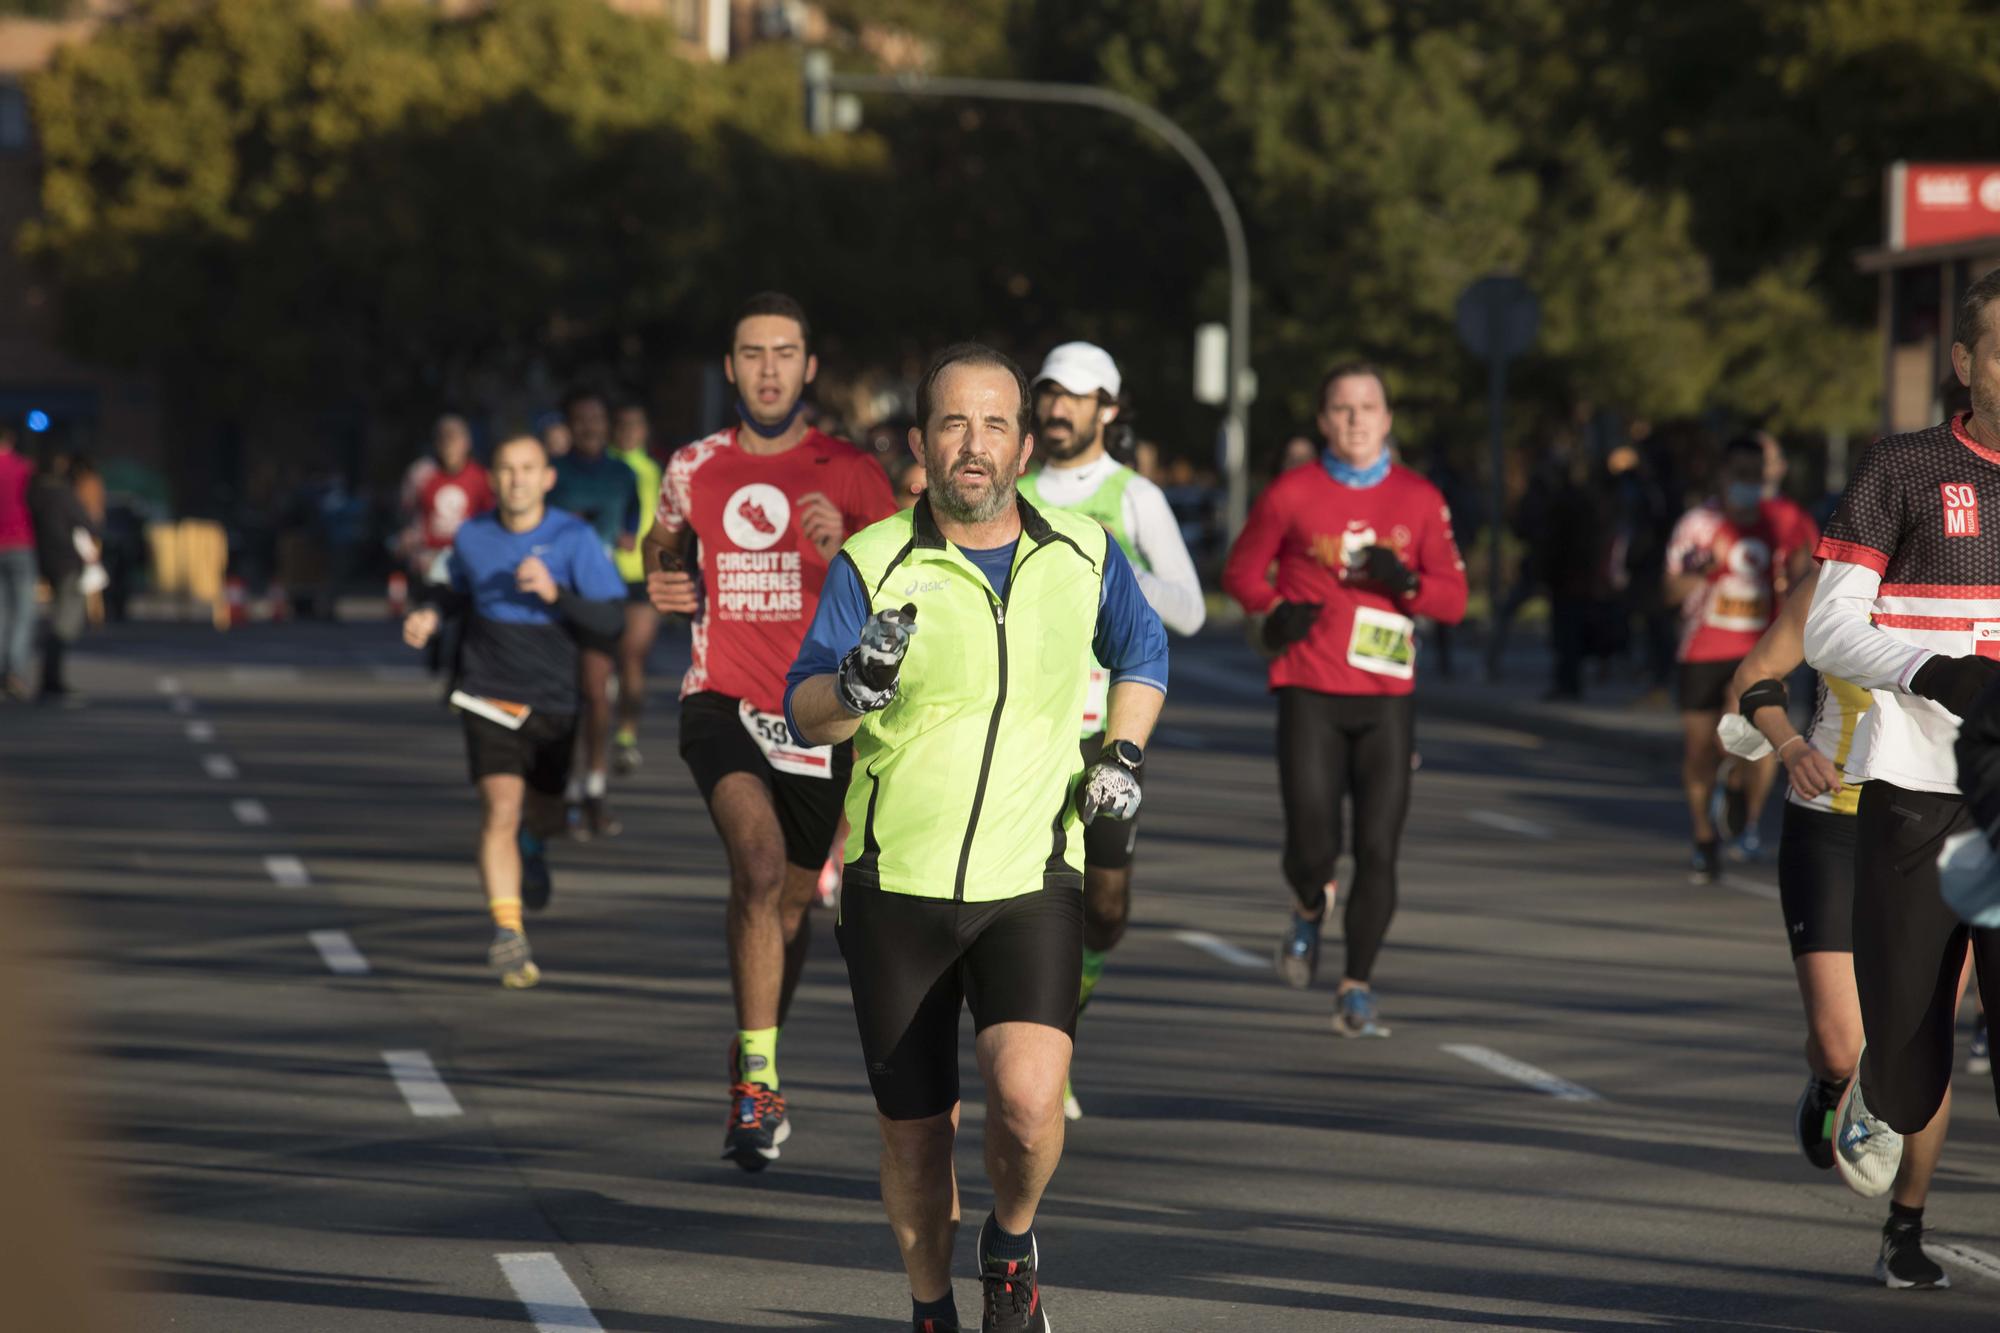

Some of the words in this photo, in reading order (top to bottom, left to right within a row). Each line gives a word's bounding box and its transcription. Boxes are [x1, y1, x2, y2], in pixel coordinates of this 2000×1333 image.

[1944, 485, 1975, 508] SO
[1947, 509, 1966, 533] M
[716, 552, 778, 571] CIRCUIT
[781, 551, 801, 571] DE
[717, 572, 802, 591] CARRERES
[718, 592, 803, 612] POPULARS
[757, 716, 797, 745] 59
